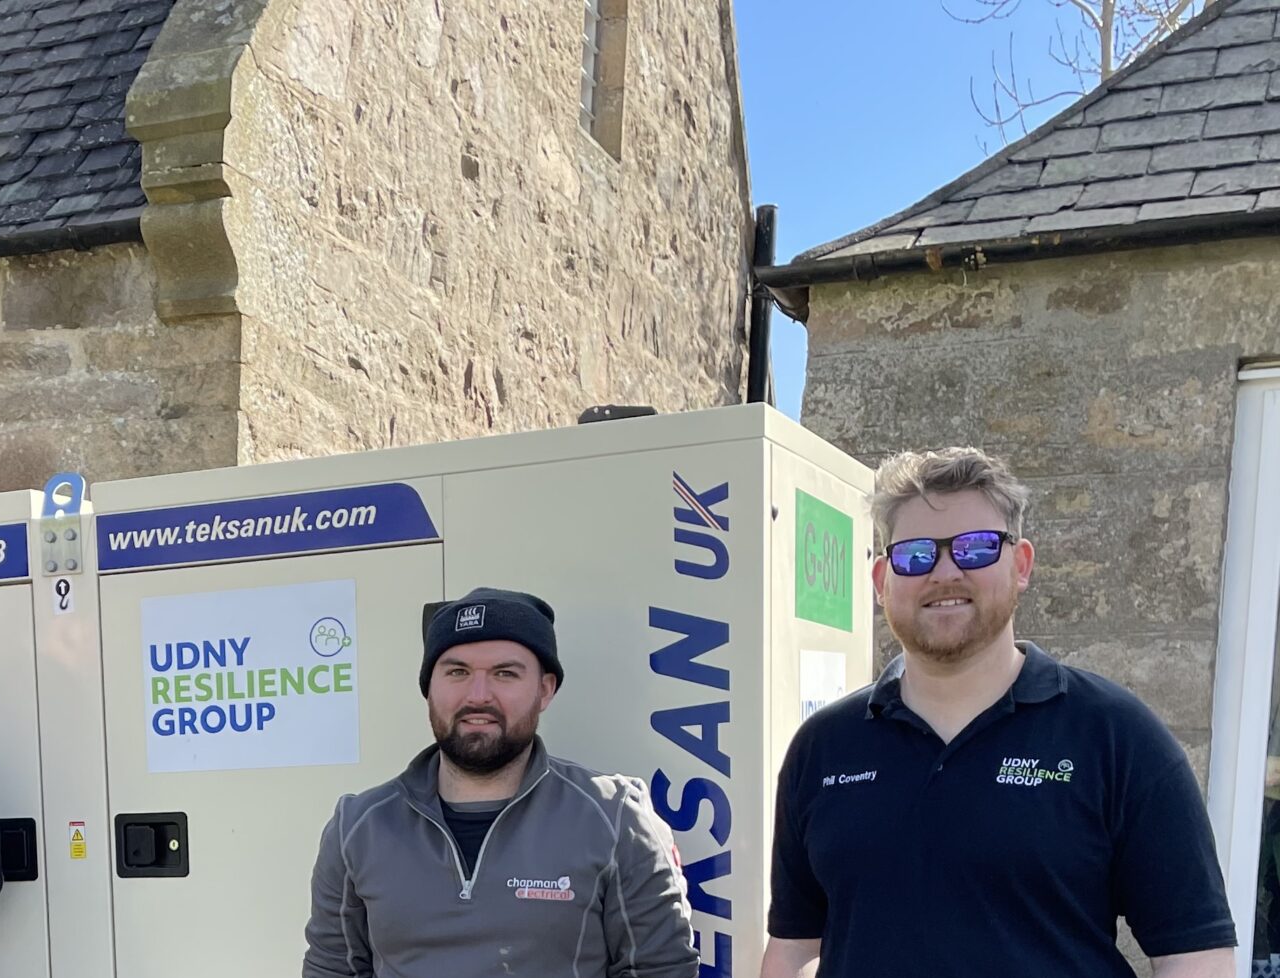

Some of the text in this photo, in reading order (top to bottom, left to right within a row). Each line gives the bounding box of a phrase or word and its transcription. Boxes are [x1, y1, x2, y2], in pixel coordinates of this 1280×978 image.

[108, 504, 377, 550] www.teksanuk.com
[673, 470, 730, 580] UK
[804, 521, 846, 599] G-801
[150, 637, 251, 672] UDNY
[151, 663, 353, 704] RESILIENCE
[152, 702, 276, 737] GROUP
[822, 770, 878, 788] Phil Coventry
[996, 774, 1043, 787] GROUP
[999, 766, 1072, 782] RESILIENCE
[1002, 757, 1040, 769] UDNY
[507, 877, 558, 897] chapman
